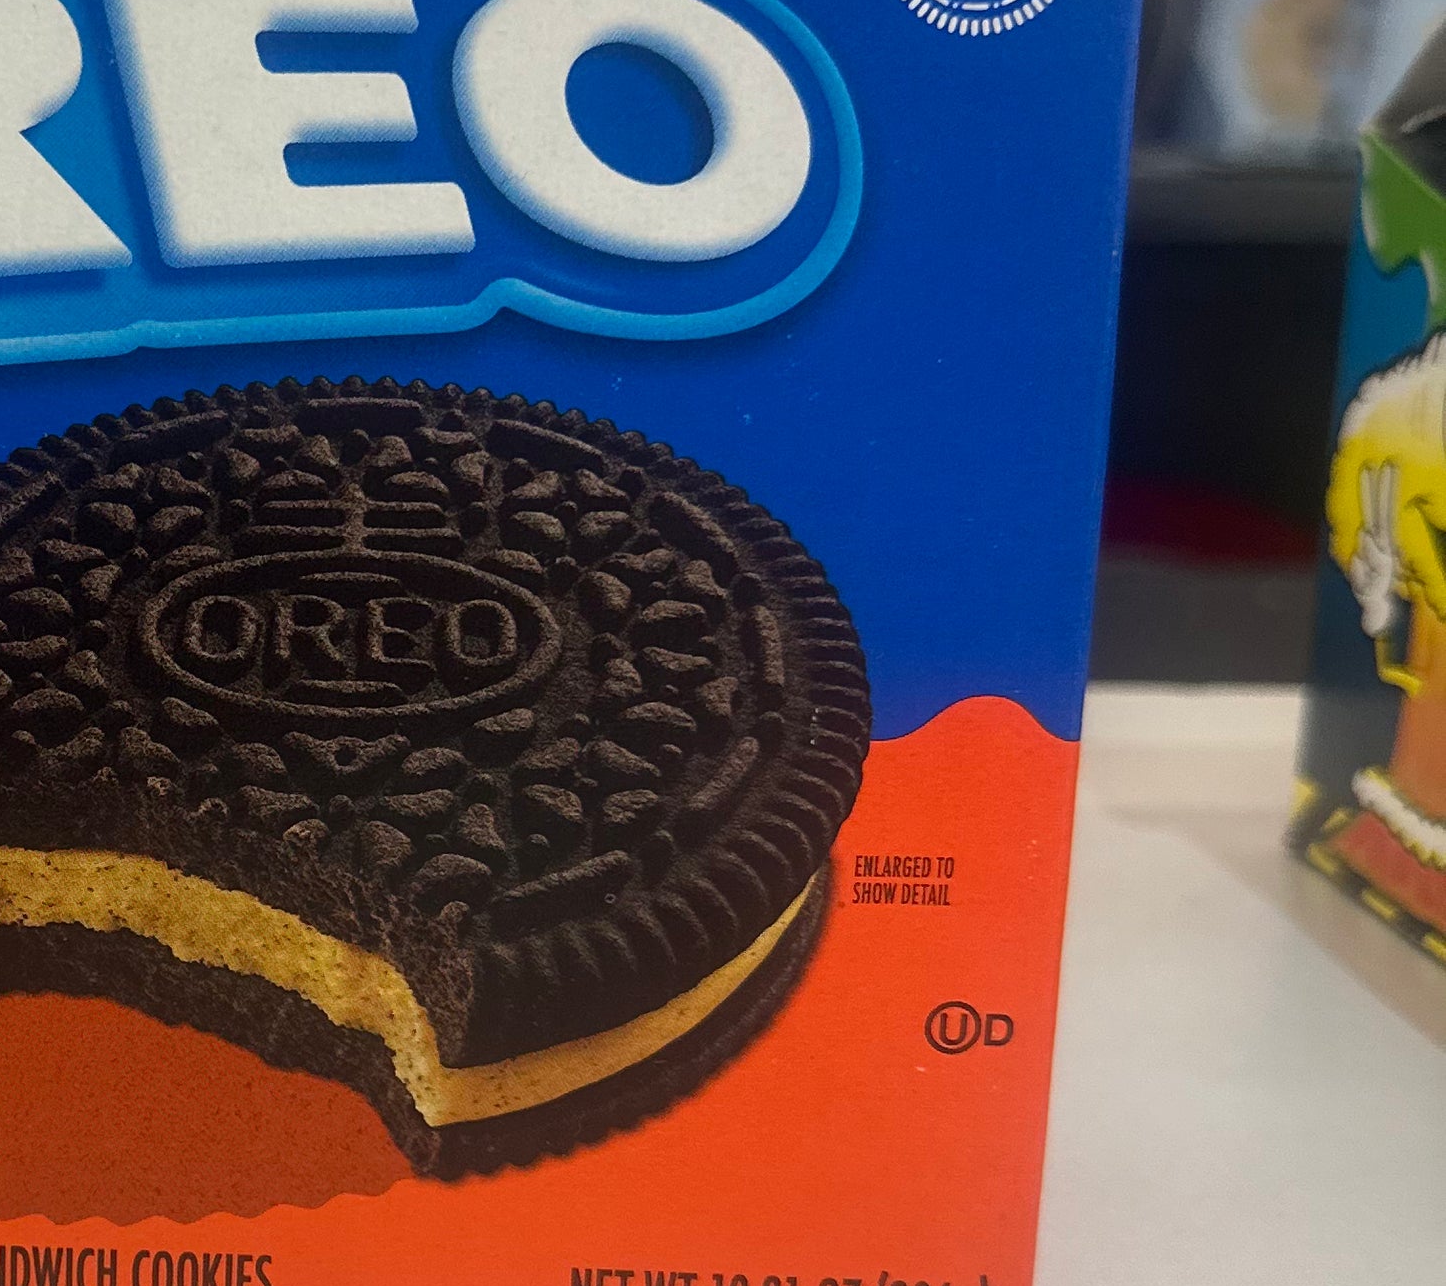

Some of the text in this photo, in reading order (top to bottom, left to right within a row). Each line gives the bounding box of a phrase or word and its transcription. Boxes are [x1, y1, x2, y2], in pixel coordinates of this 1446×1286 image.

[183, 591, 519, 668] OREO
[854, 855, 955, 878] ENLARGED TO
[852, 882, 950, 906] SHOW DETAIL
